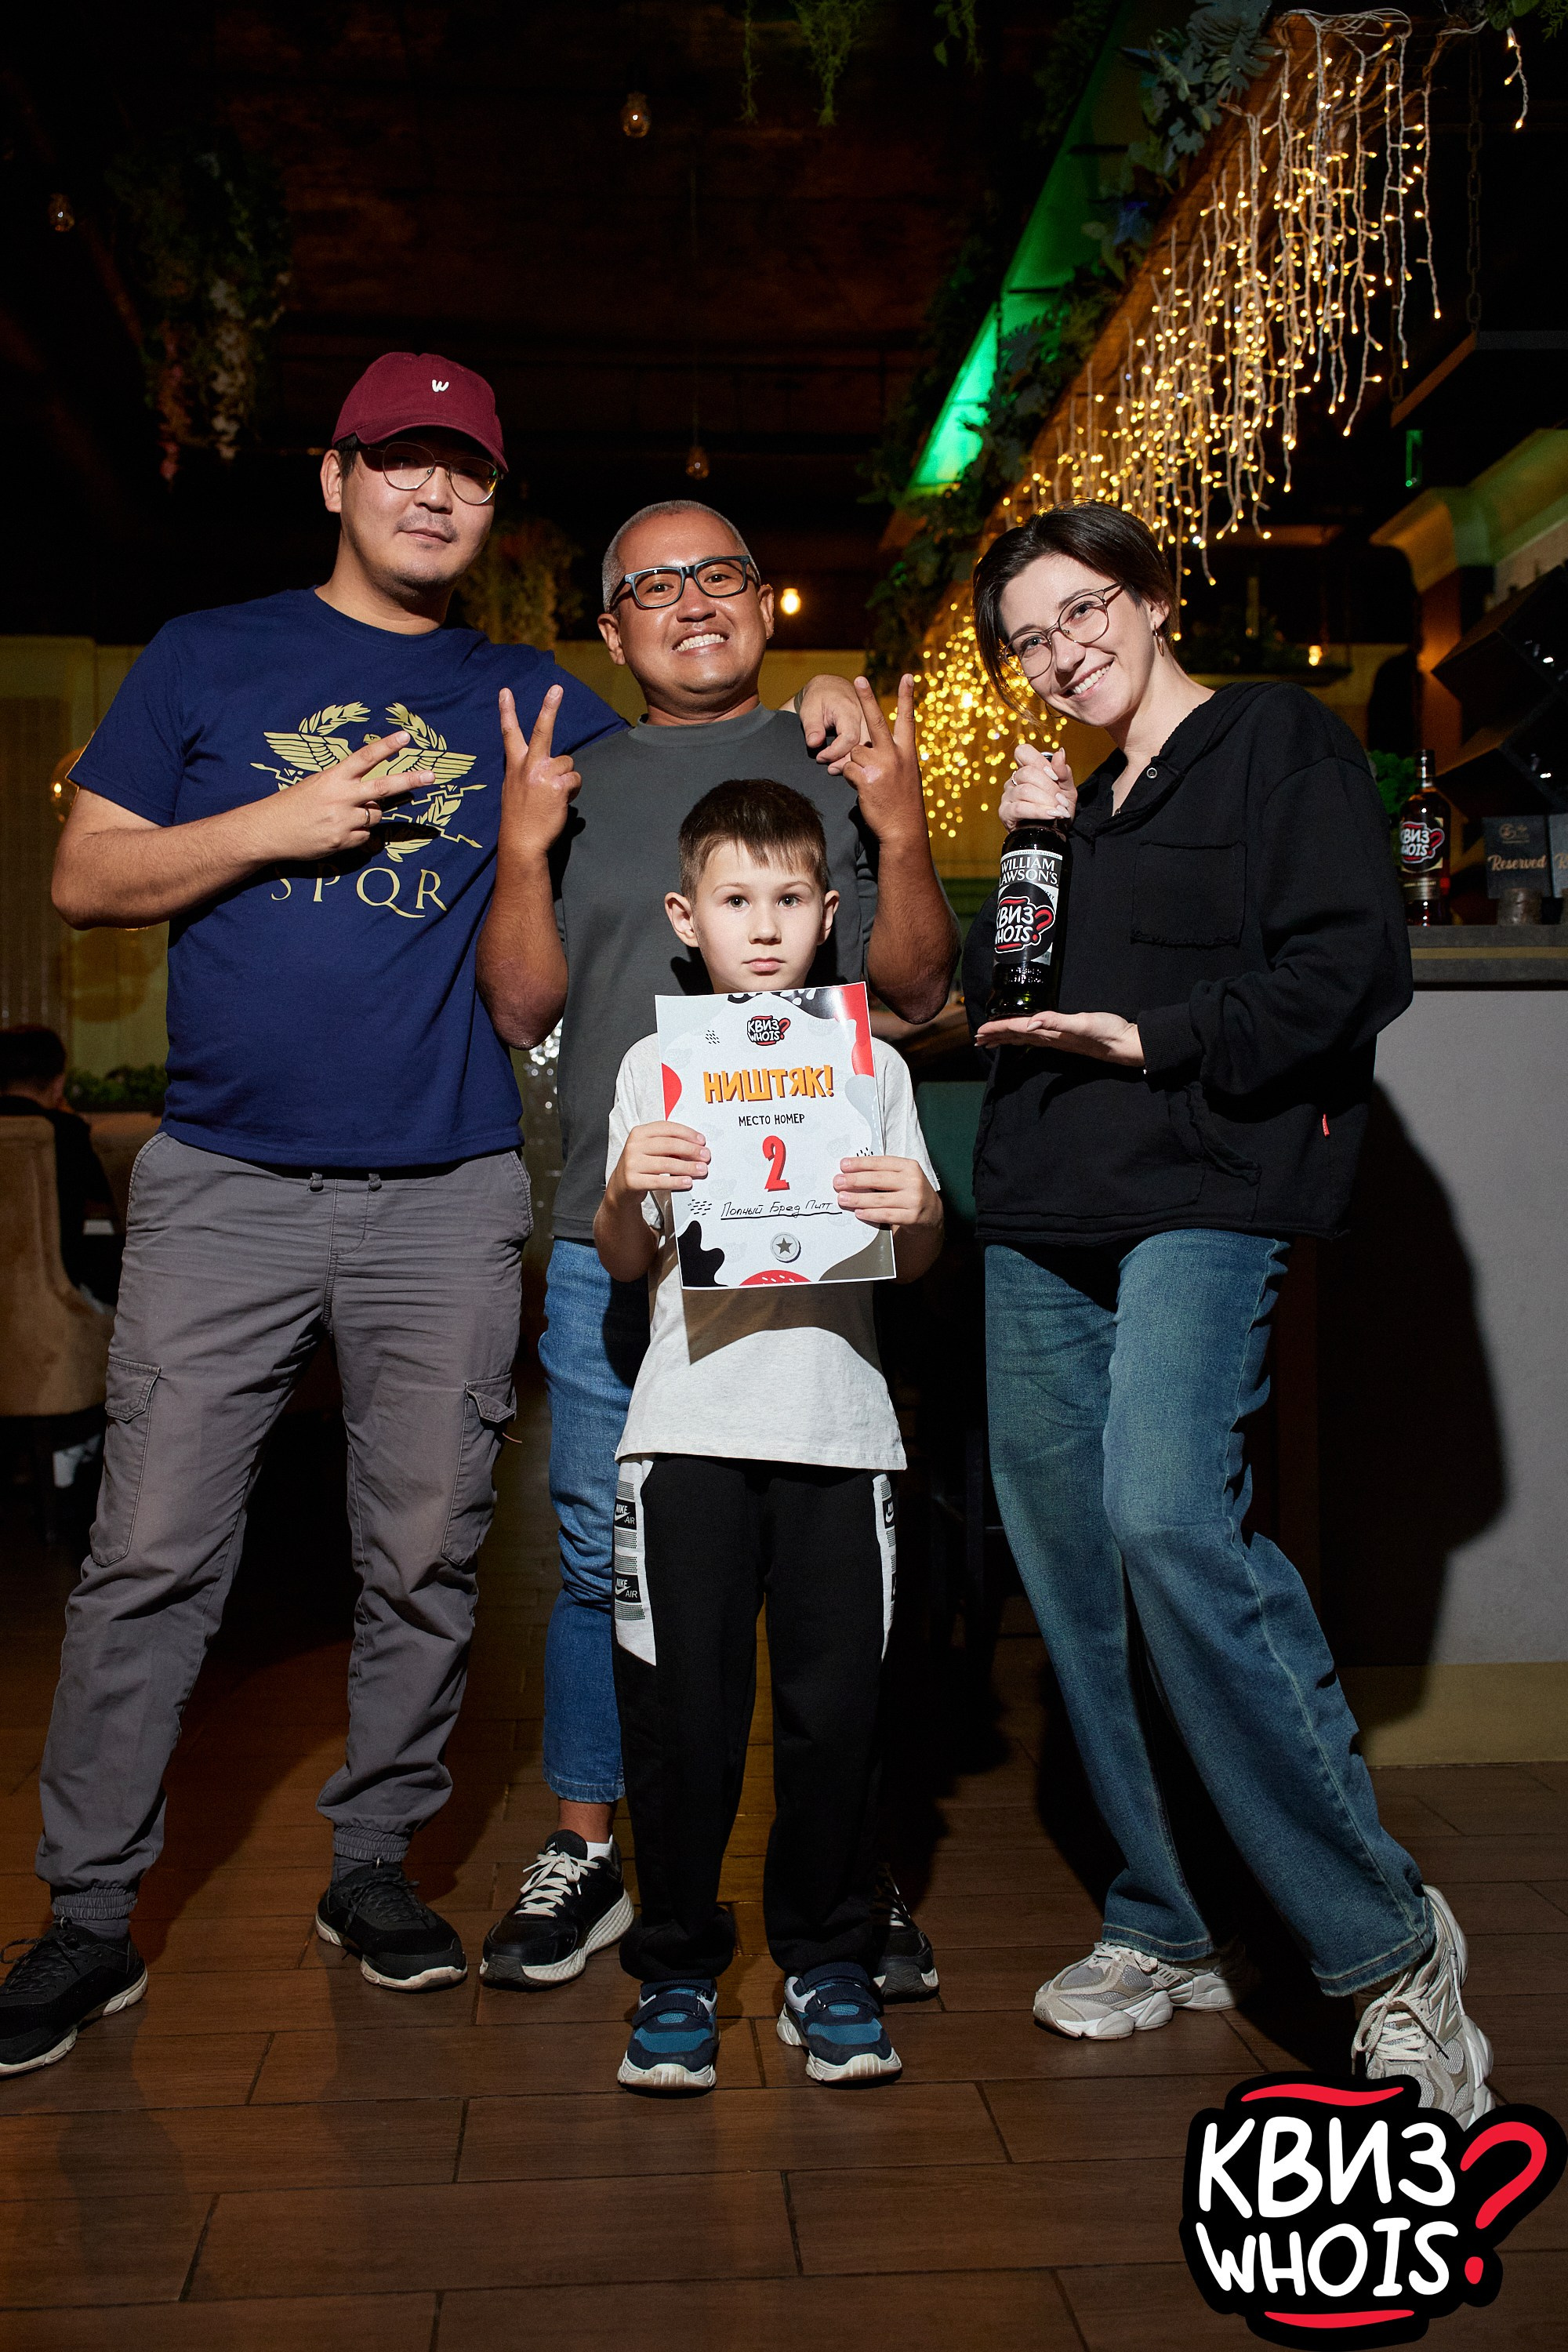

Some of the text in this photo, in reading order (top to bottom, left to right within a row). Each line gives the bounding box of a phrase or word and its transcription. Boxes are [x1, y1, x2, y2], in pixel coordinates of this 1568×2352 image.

[1001, 857, 1055, 873] WILLIAM
[1487, 854, 1547, 871] Reserved
[270, 863, 447, 918] SPQR
[747, 1019, 780, 1033] КВИЗ
[703, 1065, 834, 1104] НИШТЯК!
[739, 1113, 805, 1127] МЕСТО НОМЕР
[762, 1134, 790, 1192] 2
[770, 1201, 800, 1218] Бред
[624, 1516, 635, 1525] AIR
[625, 1590, 638, 1599] AIR
